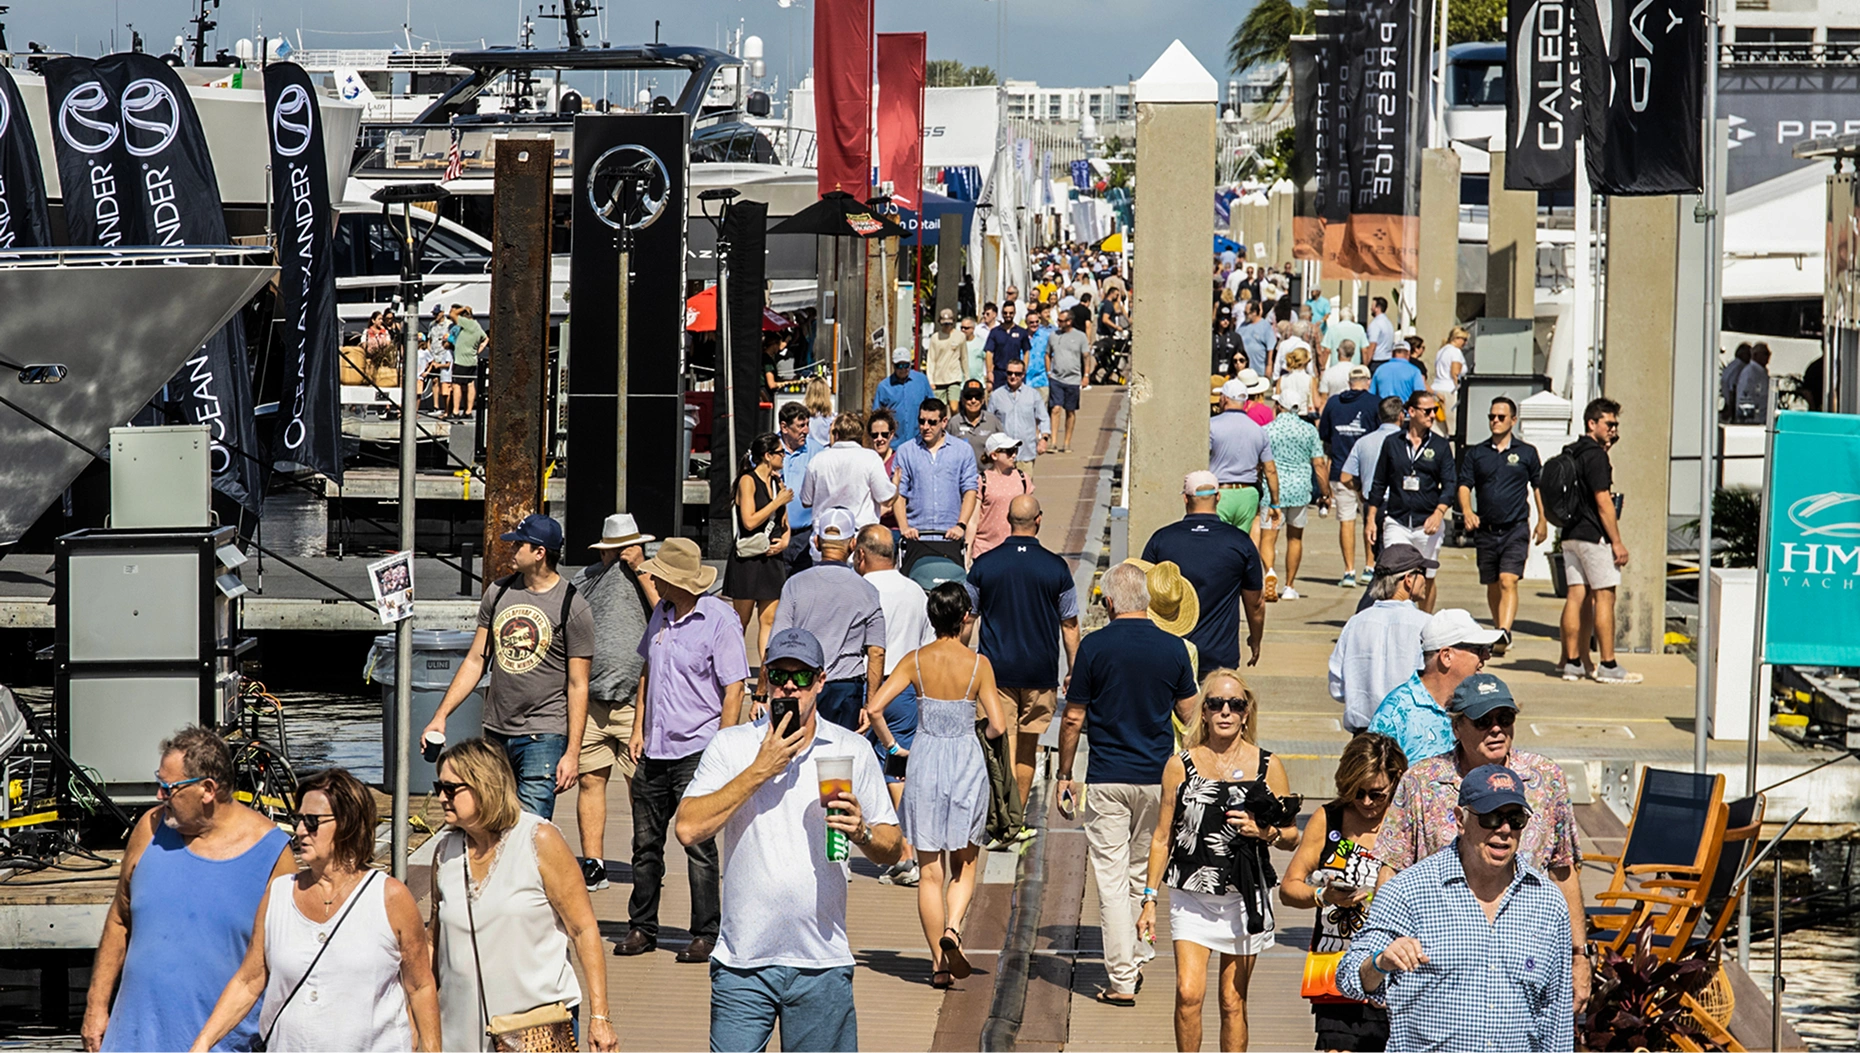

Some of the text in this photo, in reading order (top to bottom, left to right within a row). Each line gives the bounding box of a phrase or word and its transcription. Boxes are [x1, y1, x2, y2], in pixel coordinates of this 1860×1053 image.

[1537, 0, 1564, 150] GALEO
[427, 660, 449, 669] ULINE
[833, 829, 849, 863] rite
